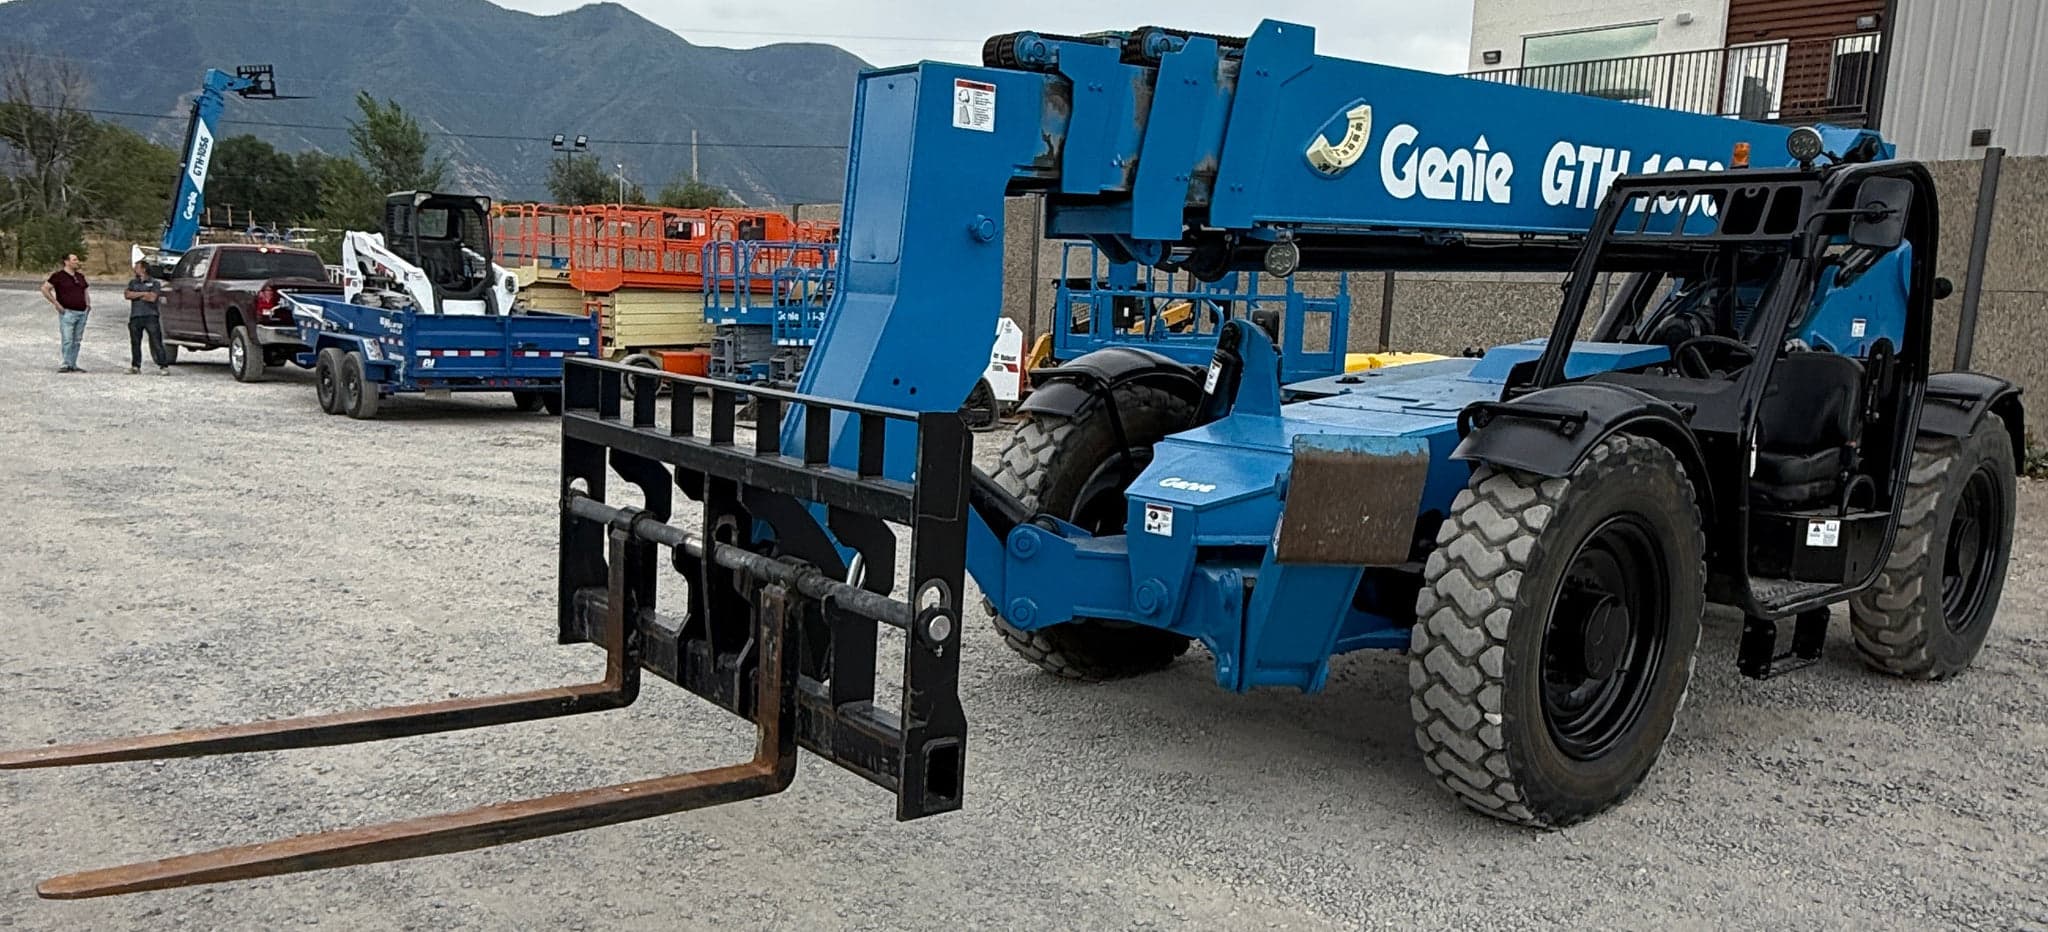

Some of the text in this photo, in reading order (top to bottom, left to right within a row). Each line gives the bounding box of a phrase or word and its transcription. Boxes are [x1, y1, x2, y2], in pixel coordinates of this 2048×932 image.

[183, 135, 209, 220] Genie GTH-1056
[1380, 123, 1514, 204] Genie
[1541, 140, 1631, 210] GTH
[1159, 476, 1217, 493] Genie
